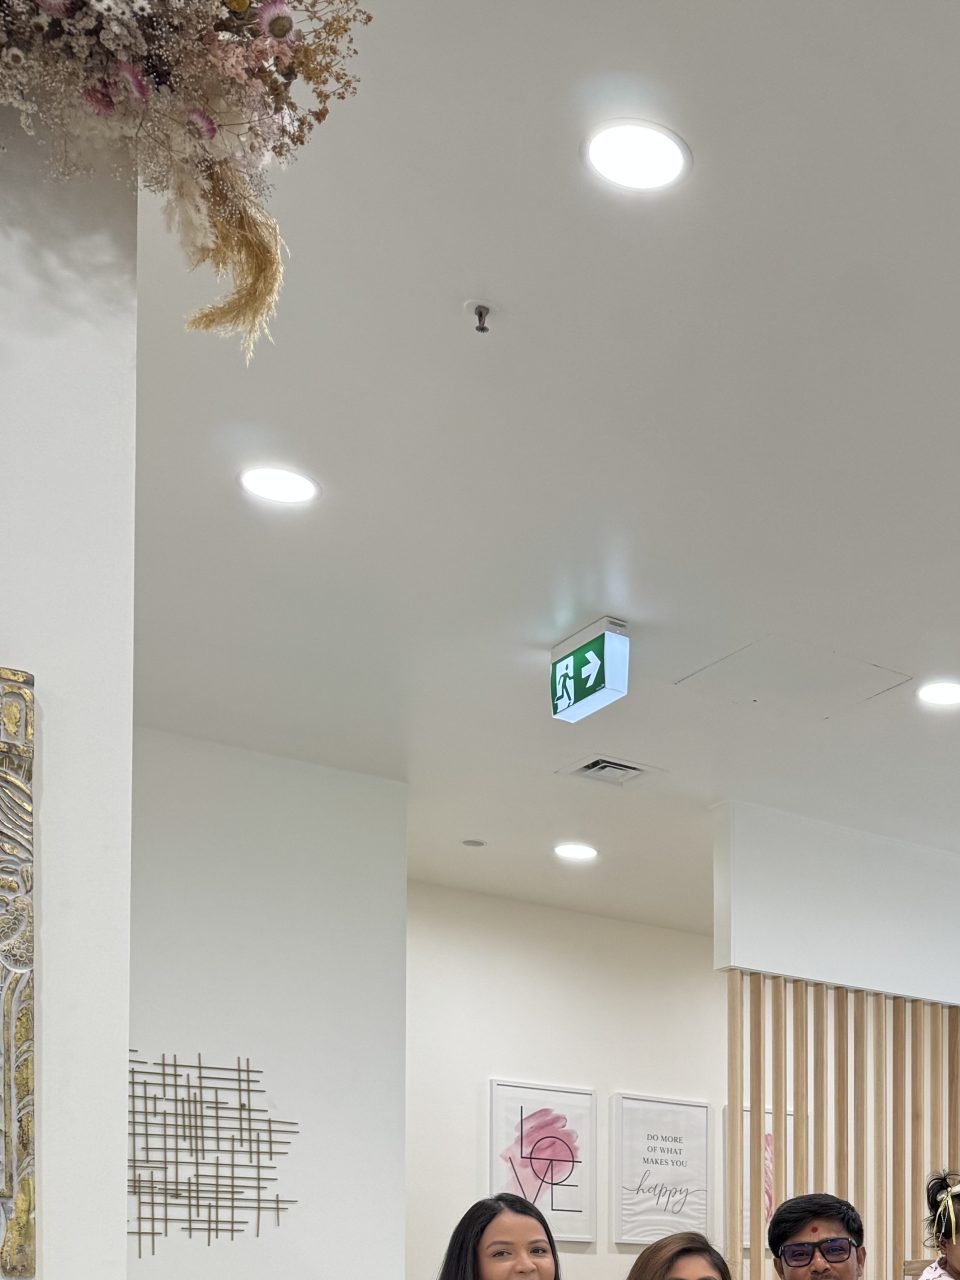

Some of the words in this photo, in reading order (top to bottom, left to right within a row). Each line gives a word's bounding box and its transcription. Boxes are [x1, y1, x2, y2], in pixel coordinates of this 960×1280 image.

[646, 1133, 659, 1143] DO
[660, 1134, 684, 1144] MORE
[647, 1145, 658, 1154] OF
[659, 1146, 683, 1156] WHAT
[508, 1105, 583, 1213] LOVE
[642, 1156, 669, 1166] MAKES
[670, 1158, 688, 1168] YOU
[622, 1169, 708, 1214] happy
